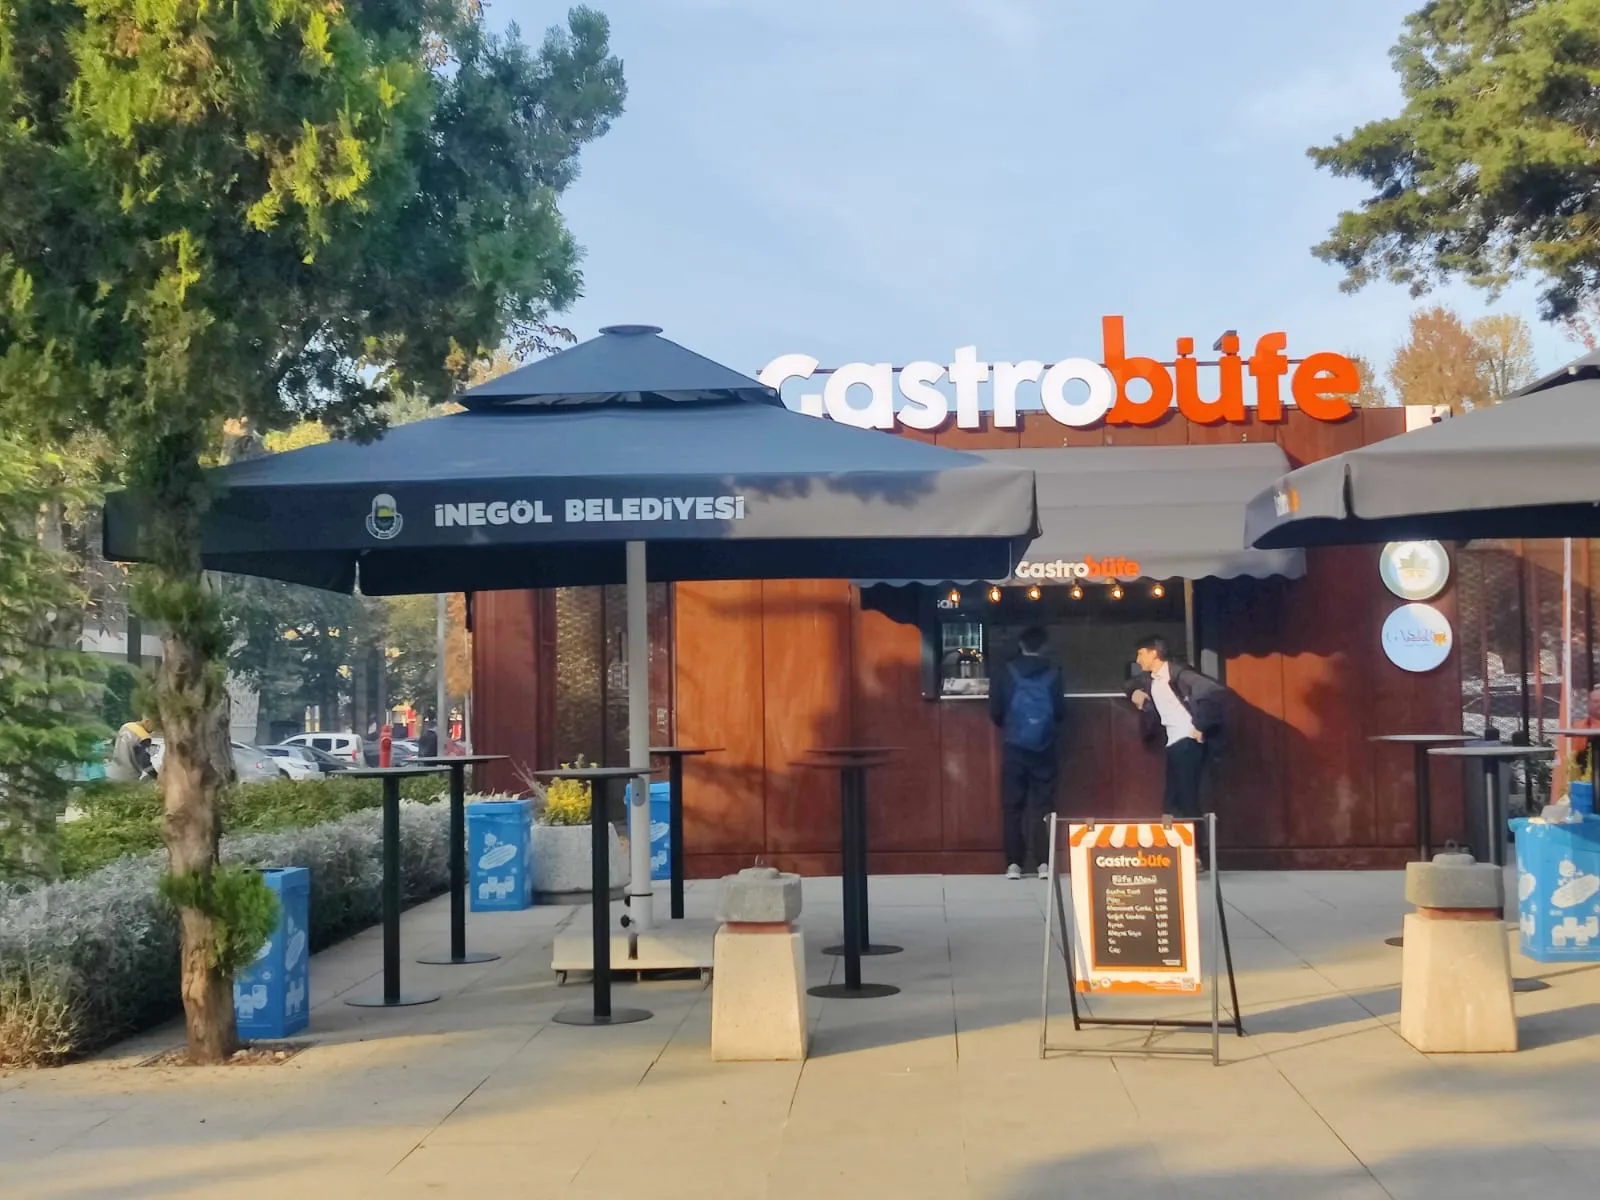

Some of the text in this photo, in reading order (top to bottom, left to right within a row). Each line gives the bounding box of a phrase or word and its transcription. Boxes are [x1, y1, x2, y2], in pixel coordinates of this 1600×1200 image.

[758, 315, 1361, 429] Gastrobüfe
[1015, 554, 1139, 578] Gastrobüfe
[1096, 850, 1172, 868] Gastrobüfe
